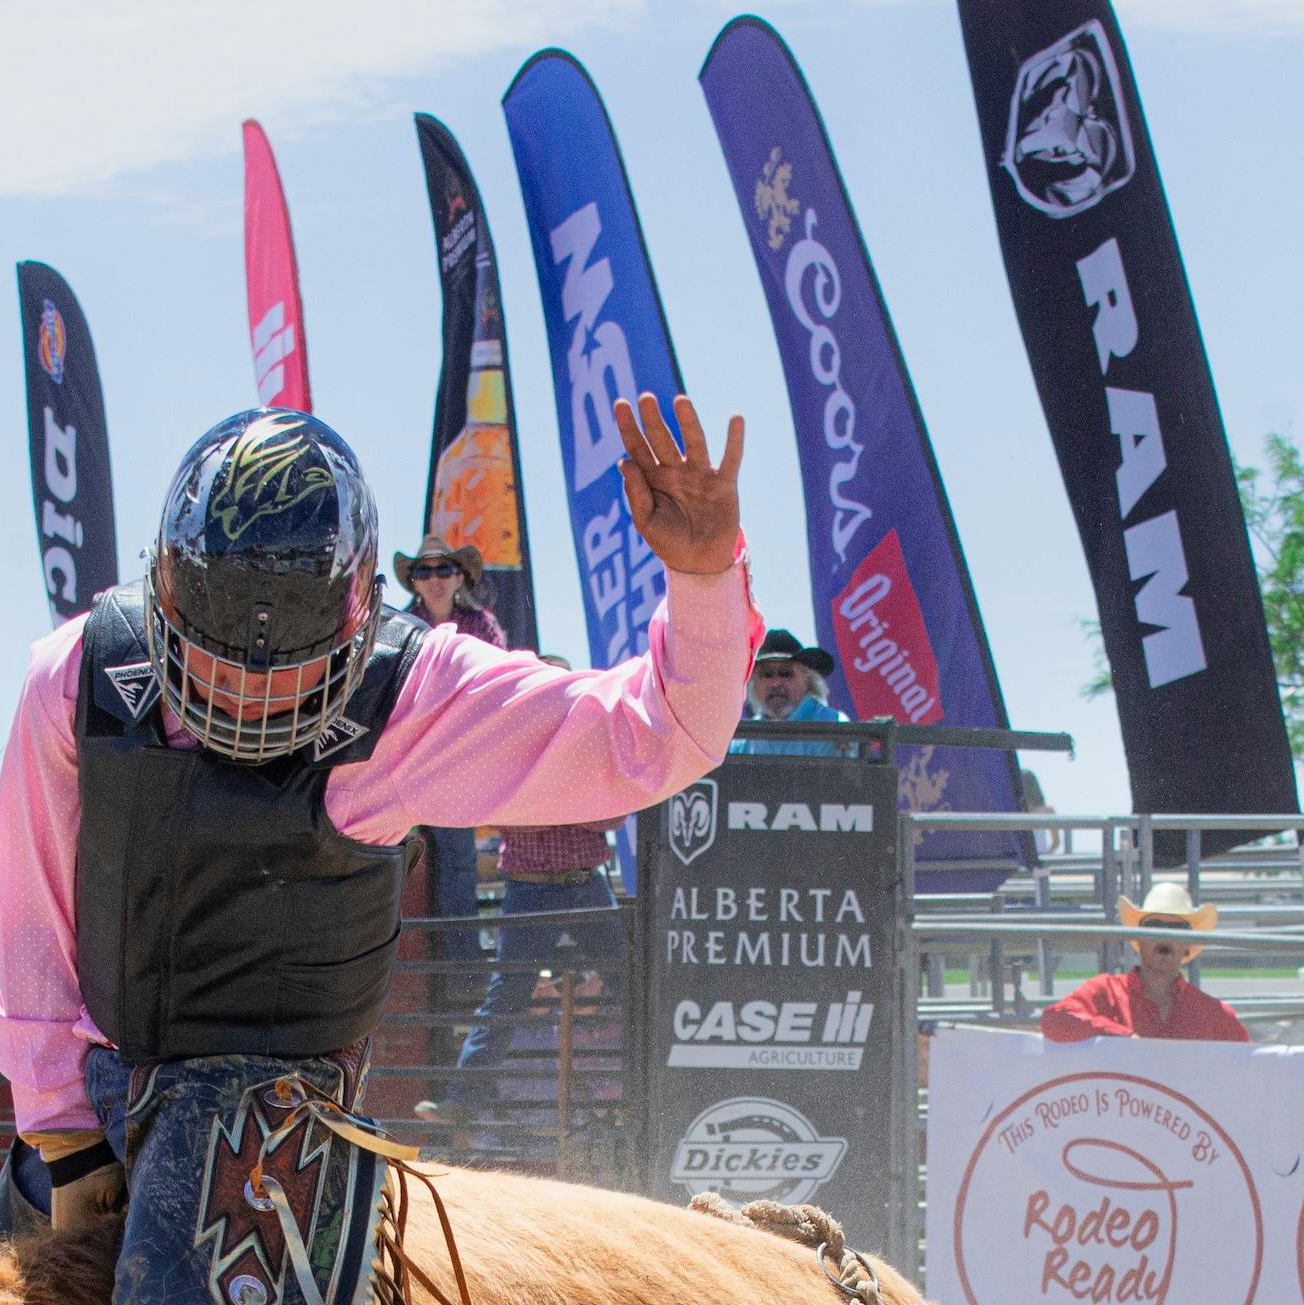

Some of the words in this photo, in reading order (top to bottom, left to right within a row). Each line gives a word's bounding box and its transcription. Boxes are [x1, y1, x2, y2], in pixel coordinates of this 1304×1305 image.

[783, 208, 872, 567] Coors
[1076, 236, 1206, 689] RAM
[840, 574, 935, 723] Original
[728, 802, 873, 832] RAM
[671, 886, 865, 923] ALBERTA
[667, 930, 872, 967] PREMIUM
[673, 999, 817, 1043] CASE
[748, 1050, 856, 1066] AGRICULTURE
[683, 1147, 824, 1173] Dickies
[1023, 1189, 1160, 1252] Rodeo
